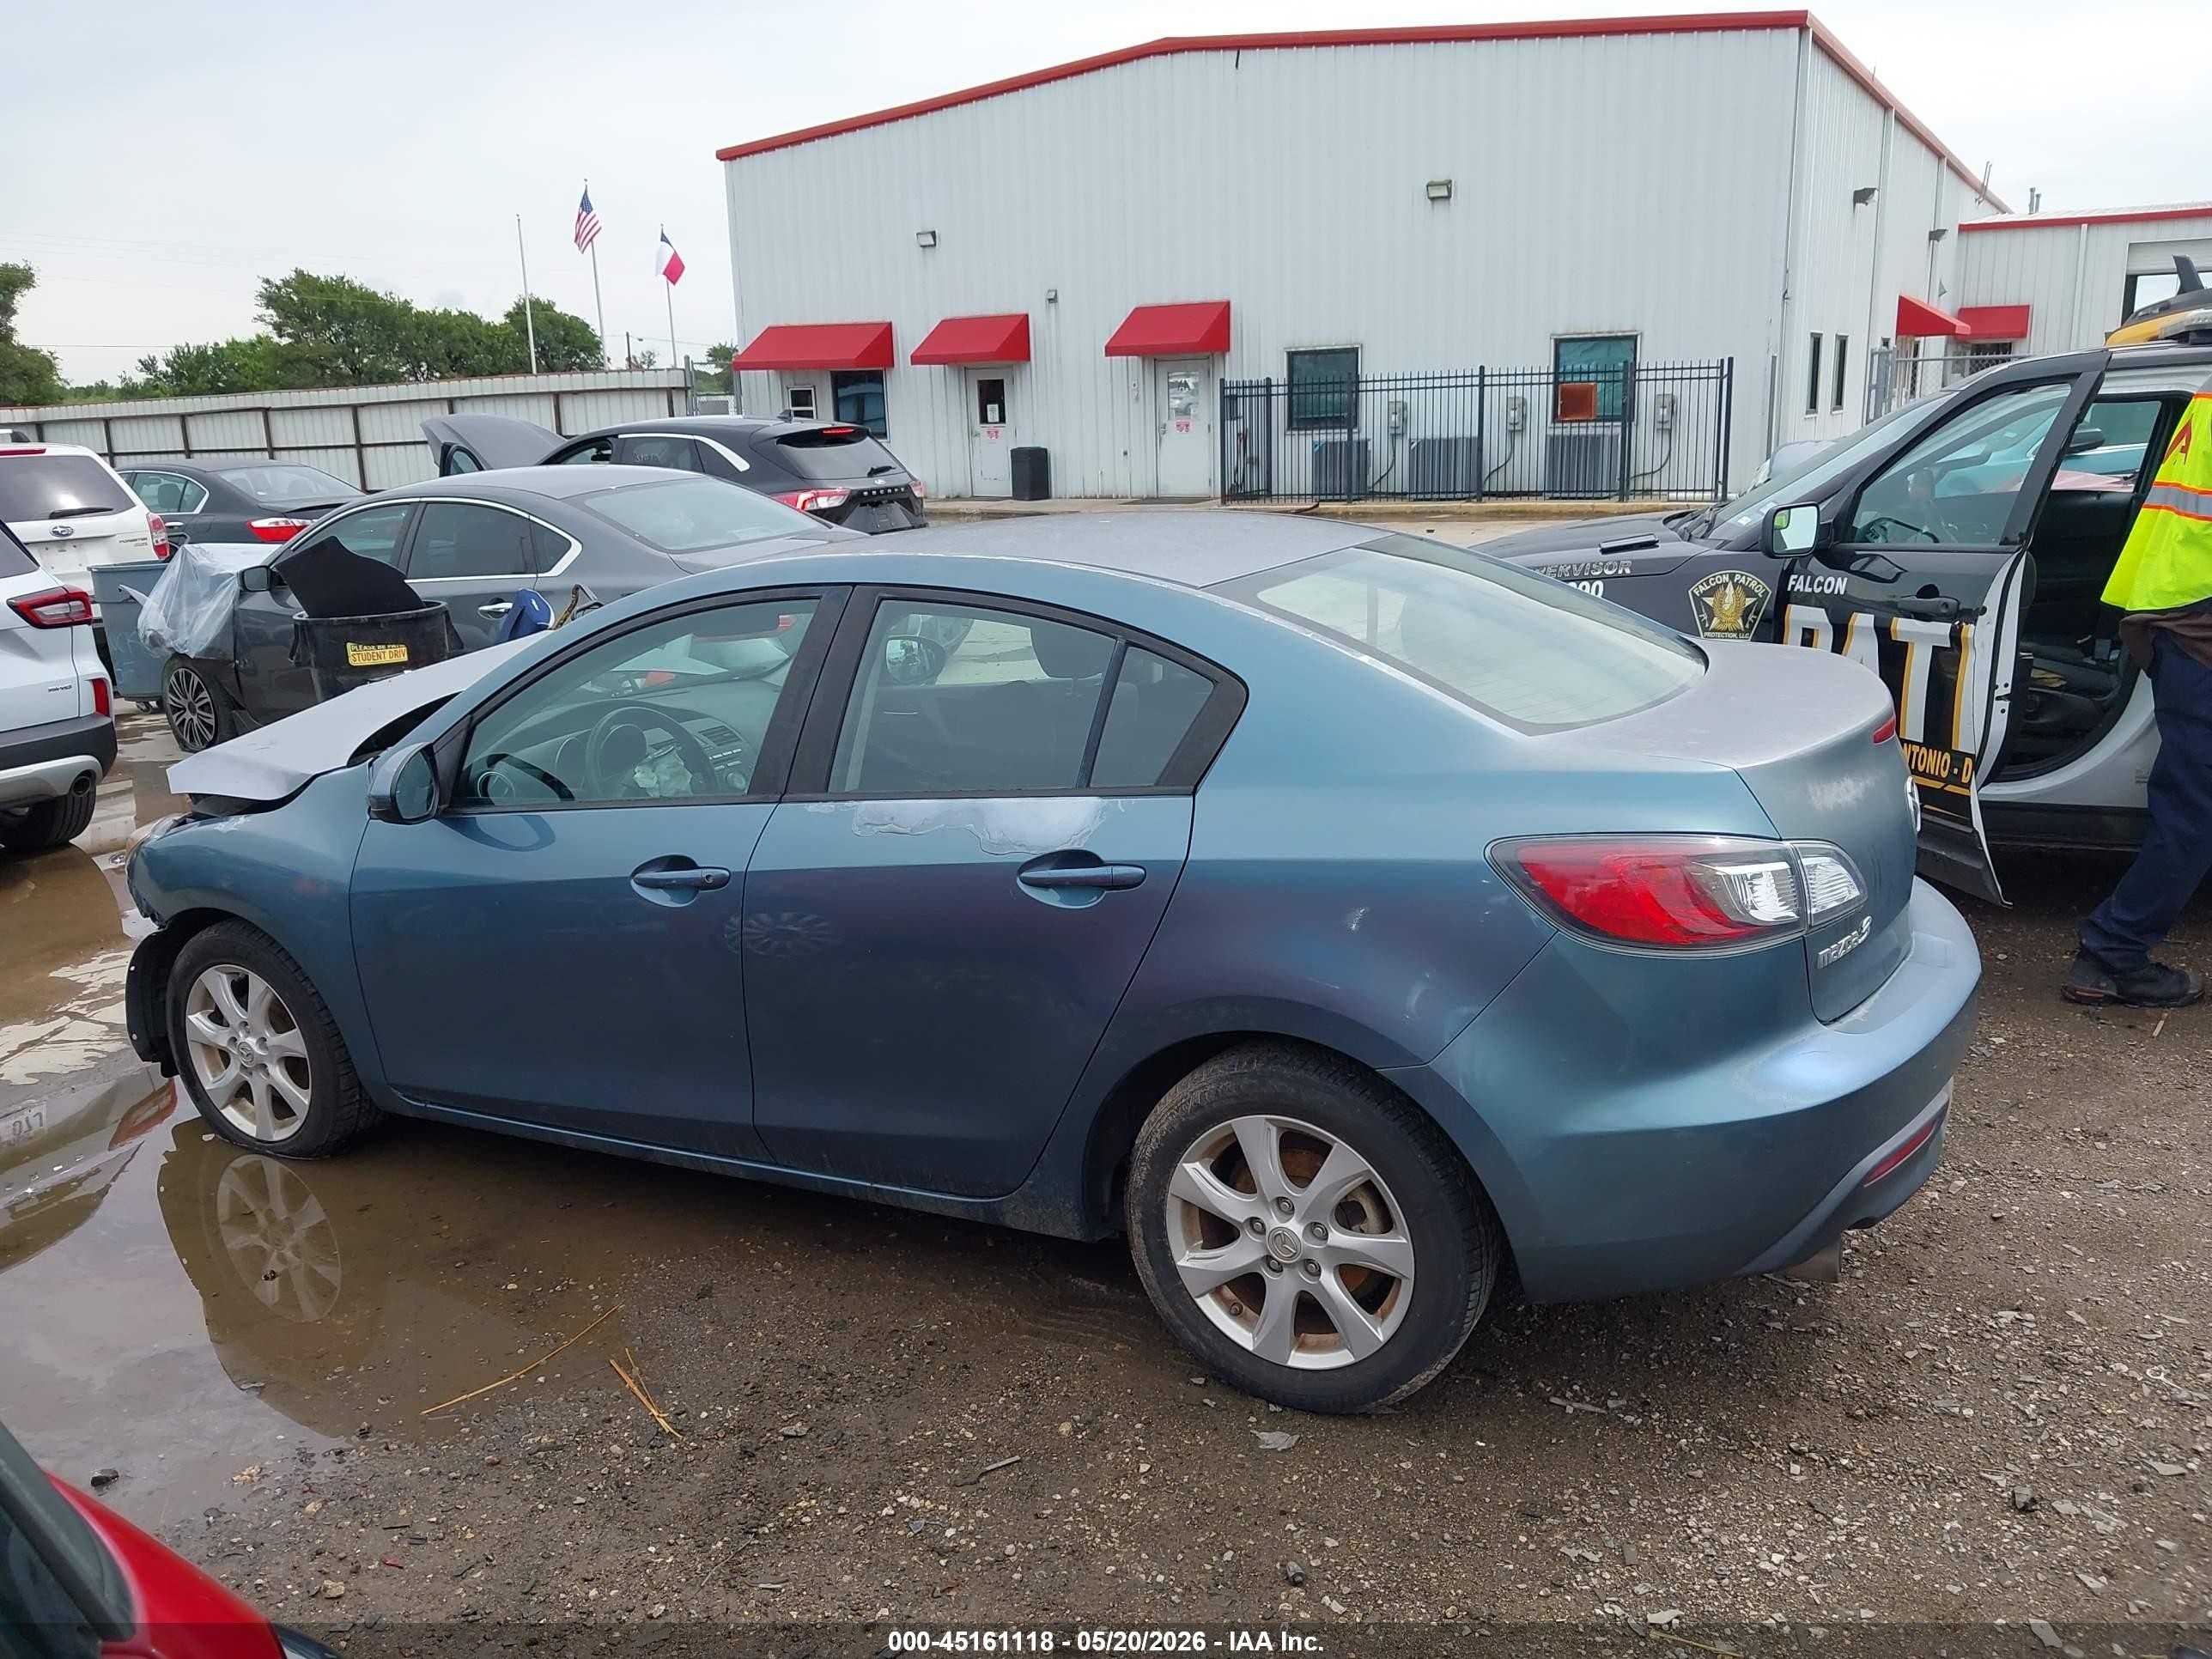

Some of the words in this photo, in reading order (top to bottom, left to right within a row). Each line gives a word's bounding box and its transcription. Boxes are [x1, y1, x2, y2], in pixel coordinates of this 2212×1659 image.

[1693, 574, 1729, 597] FALCON
[1734, 574, 1766, 598] PATROL
[1787, 574, 1848, 595] FALCON
[352, 651, 386, 662] STUDENT
[1903, 743, 1951, 778] NTONIO
